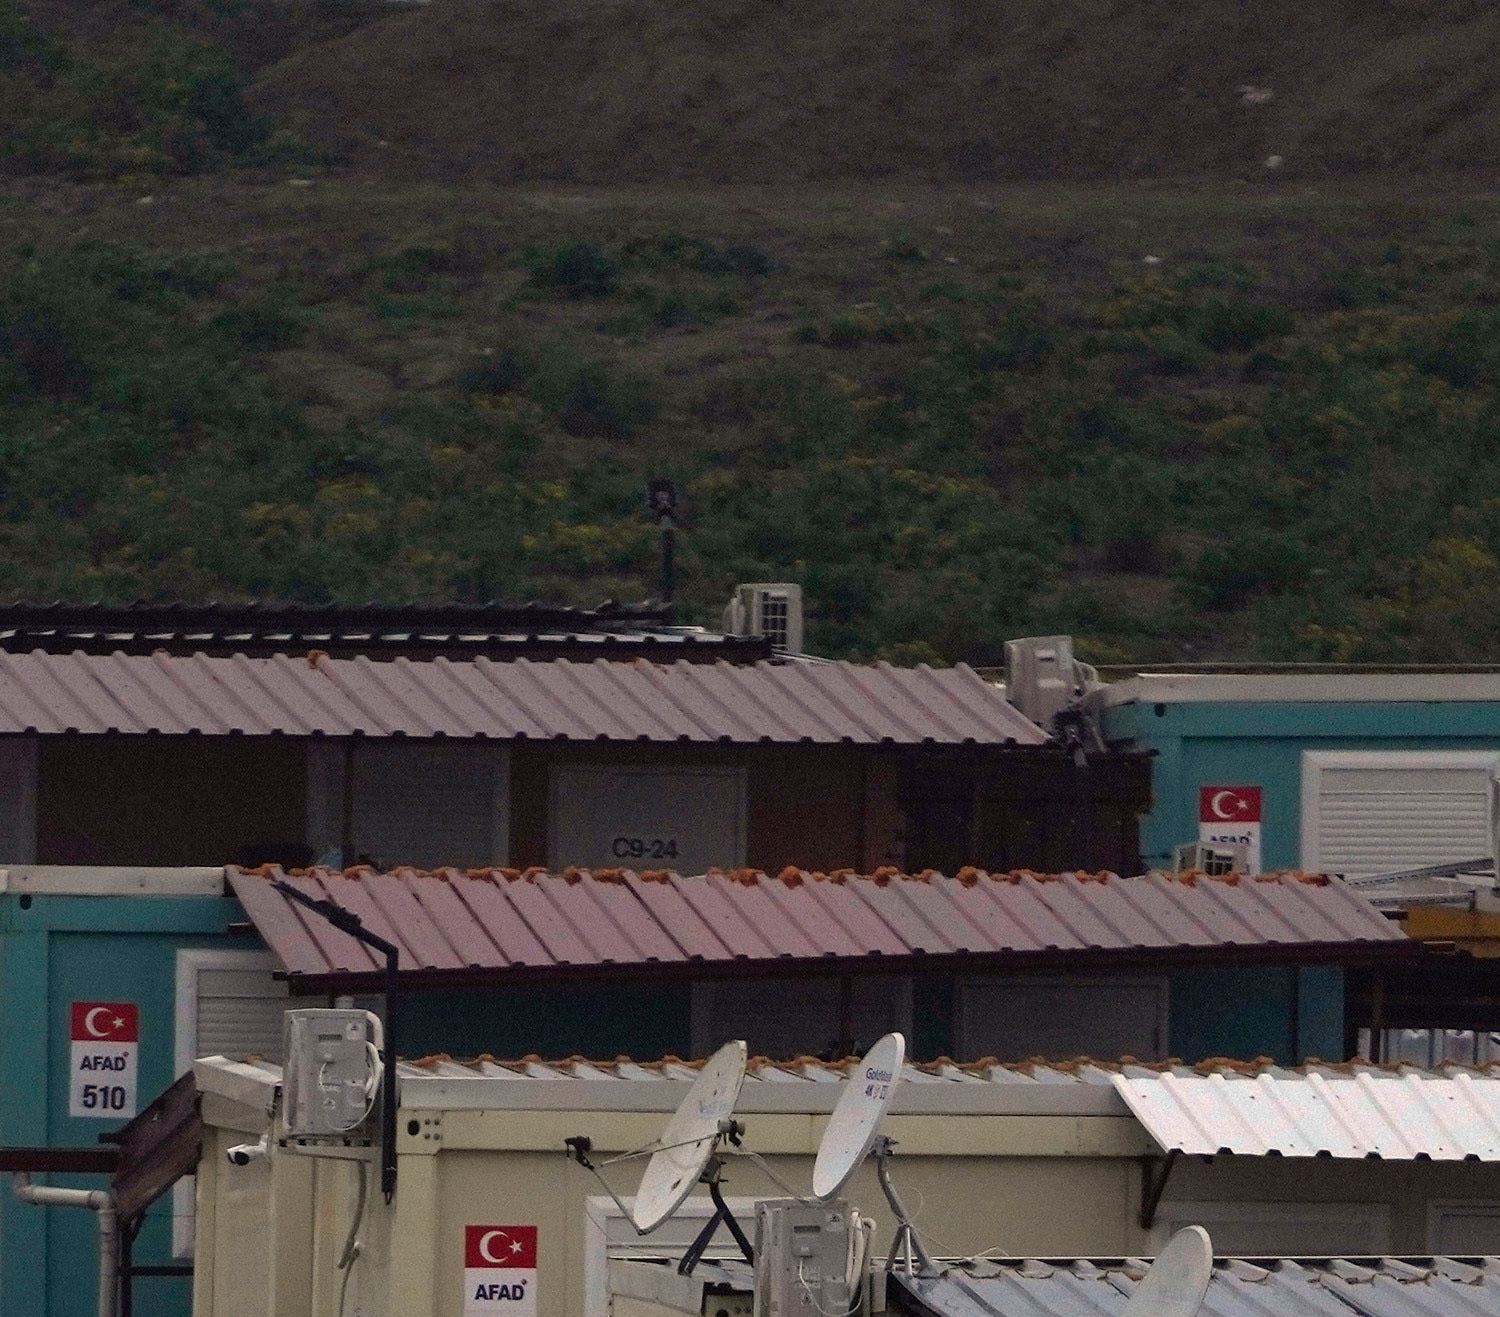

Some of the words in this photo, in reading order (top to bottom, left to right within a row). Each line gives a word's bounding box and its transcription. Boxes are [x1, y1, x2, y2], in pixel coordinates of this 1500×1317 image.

[612, 837, 680, 859] C9-24
[79, 1055, 126, 1072] AFAD
[82, 1084, 126, 1111] 510
[474, 1283, 525, 1302] AFAD
